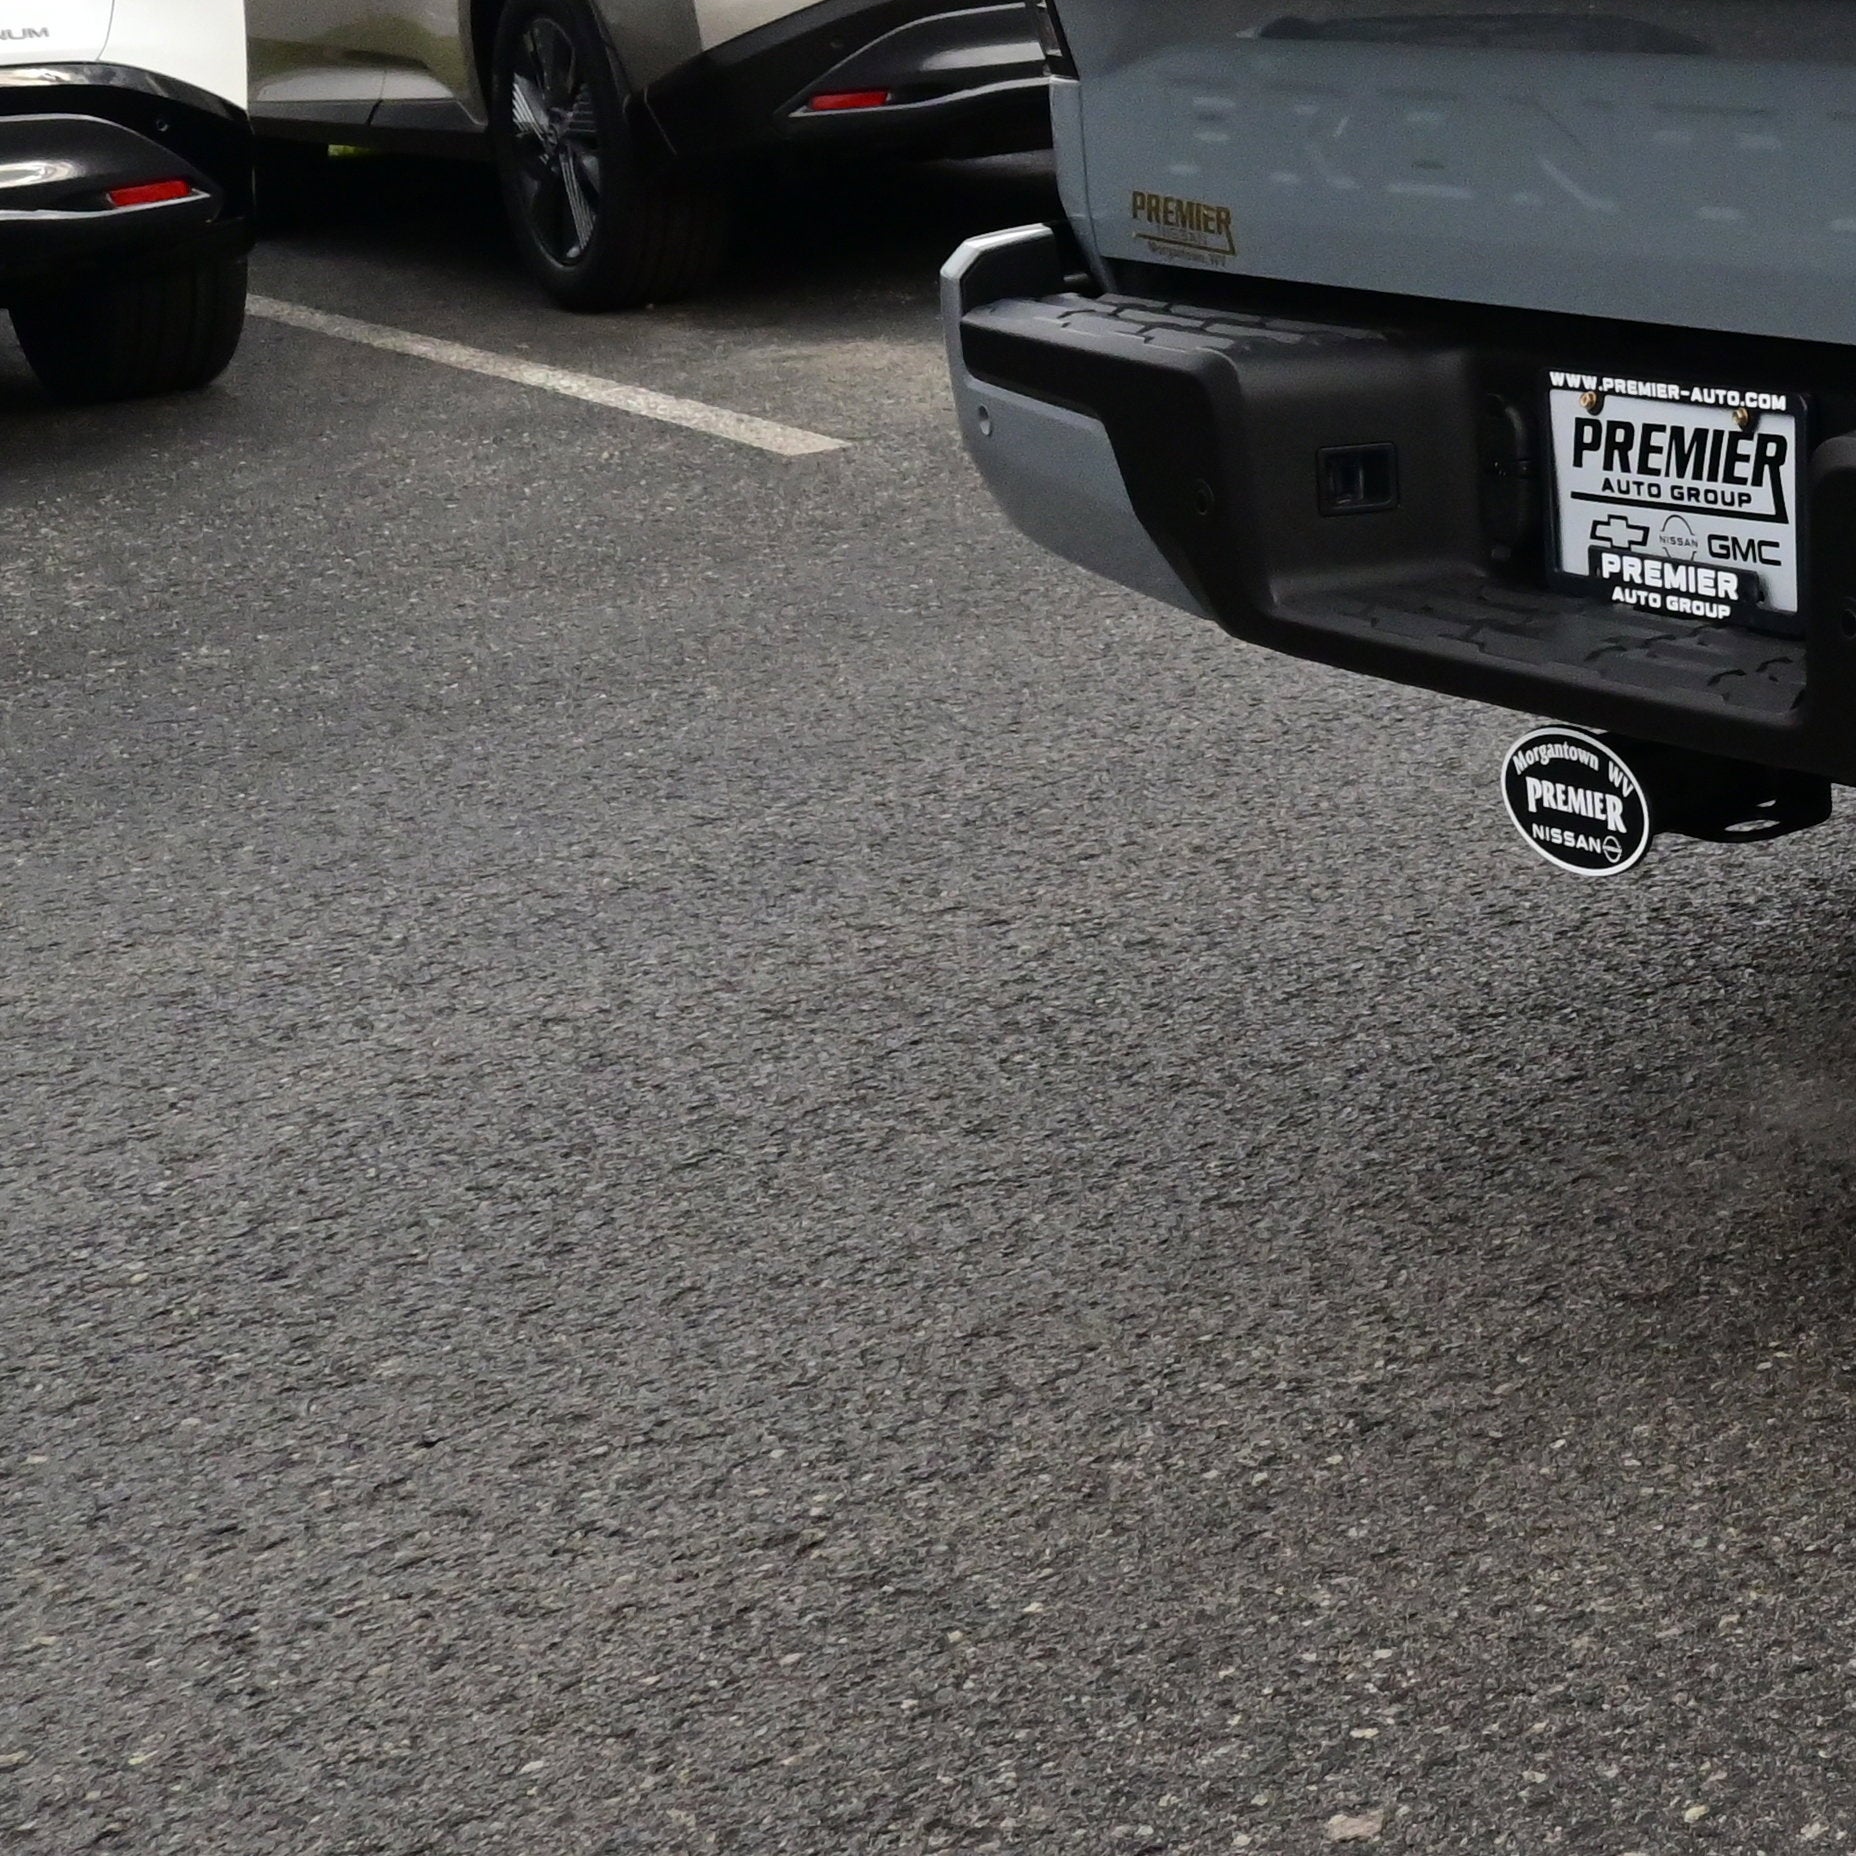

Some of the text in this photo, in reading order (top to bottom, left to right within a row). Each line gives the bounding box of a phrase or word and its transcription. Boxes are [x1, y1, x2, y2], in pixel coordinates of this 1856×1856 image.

[1131, 190, 1235, 244] PREMIER
[1549, 371, 1787, 412] WWW.PREMIER-AUTO.COM
[1572, 416, 1789, 506] PREMIER
[1601, 477, 1752, 508] AUTO GROUP
[1658, 535, 1699, 548] NISSAN
[1707, 533, 1782, 567] GMC
[1601, 552, 1739, 601] PREMIER
[1611, 586, 1732, 620] AUTO GROUP
[1512, 740, 1636, 798] Morgantown WV
[1525, 776, 1628, 834] PREMIER
[1531, 822, 1602, 854] NISSAN
